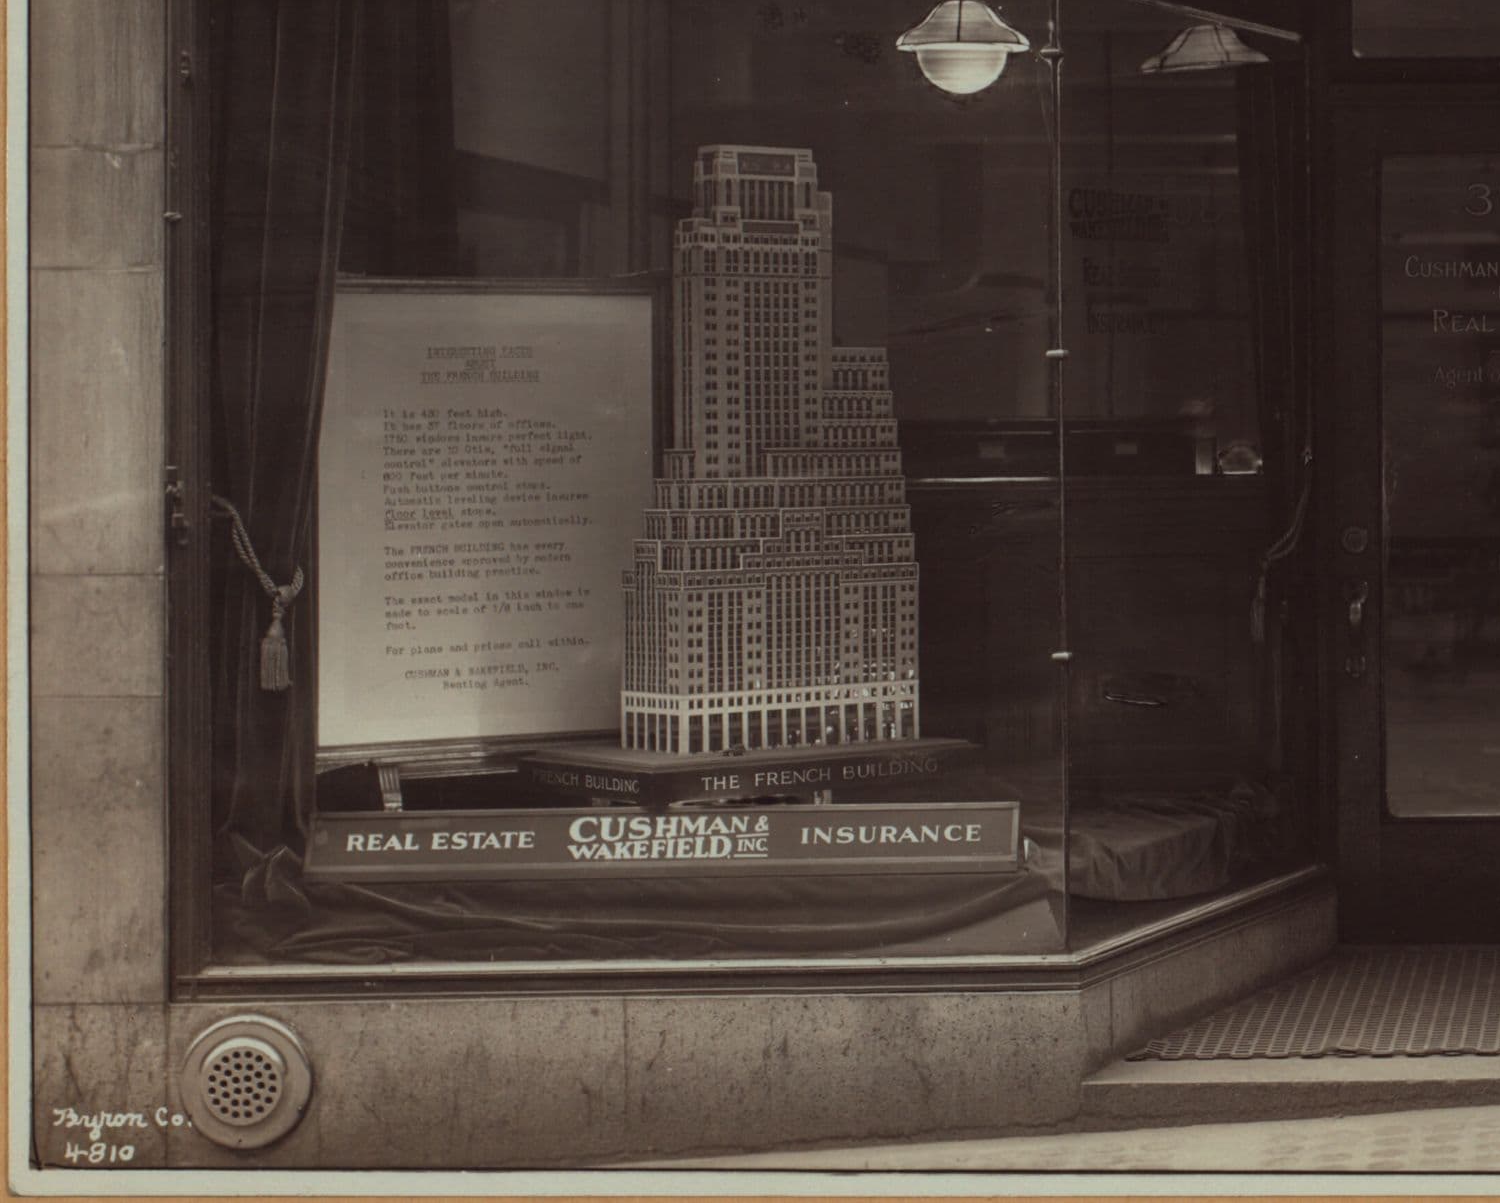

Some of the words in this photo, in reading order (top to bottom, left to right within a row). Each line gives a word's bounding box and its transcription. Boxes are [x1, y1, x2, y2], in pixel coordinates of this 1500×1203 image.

[1404, 254, 1498, 279] CUSHMAN
[1432, 309, 1497, 333] REAL
[584, 774, 640, 794] BUILDING
[701, 774, 741, 791] THE
[754, 767, 832, 787] FRENCH
[842, 757, 940, 781] BUILDING
[568, 815, 750, 843] CUSHMAN
[754, 814, 770, 832] &
[800, 824, 983, 846] INSURANCE
[346, 832, 421, 853] REAL
[430, 829, 537, 851] ESTATE
